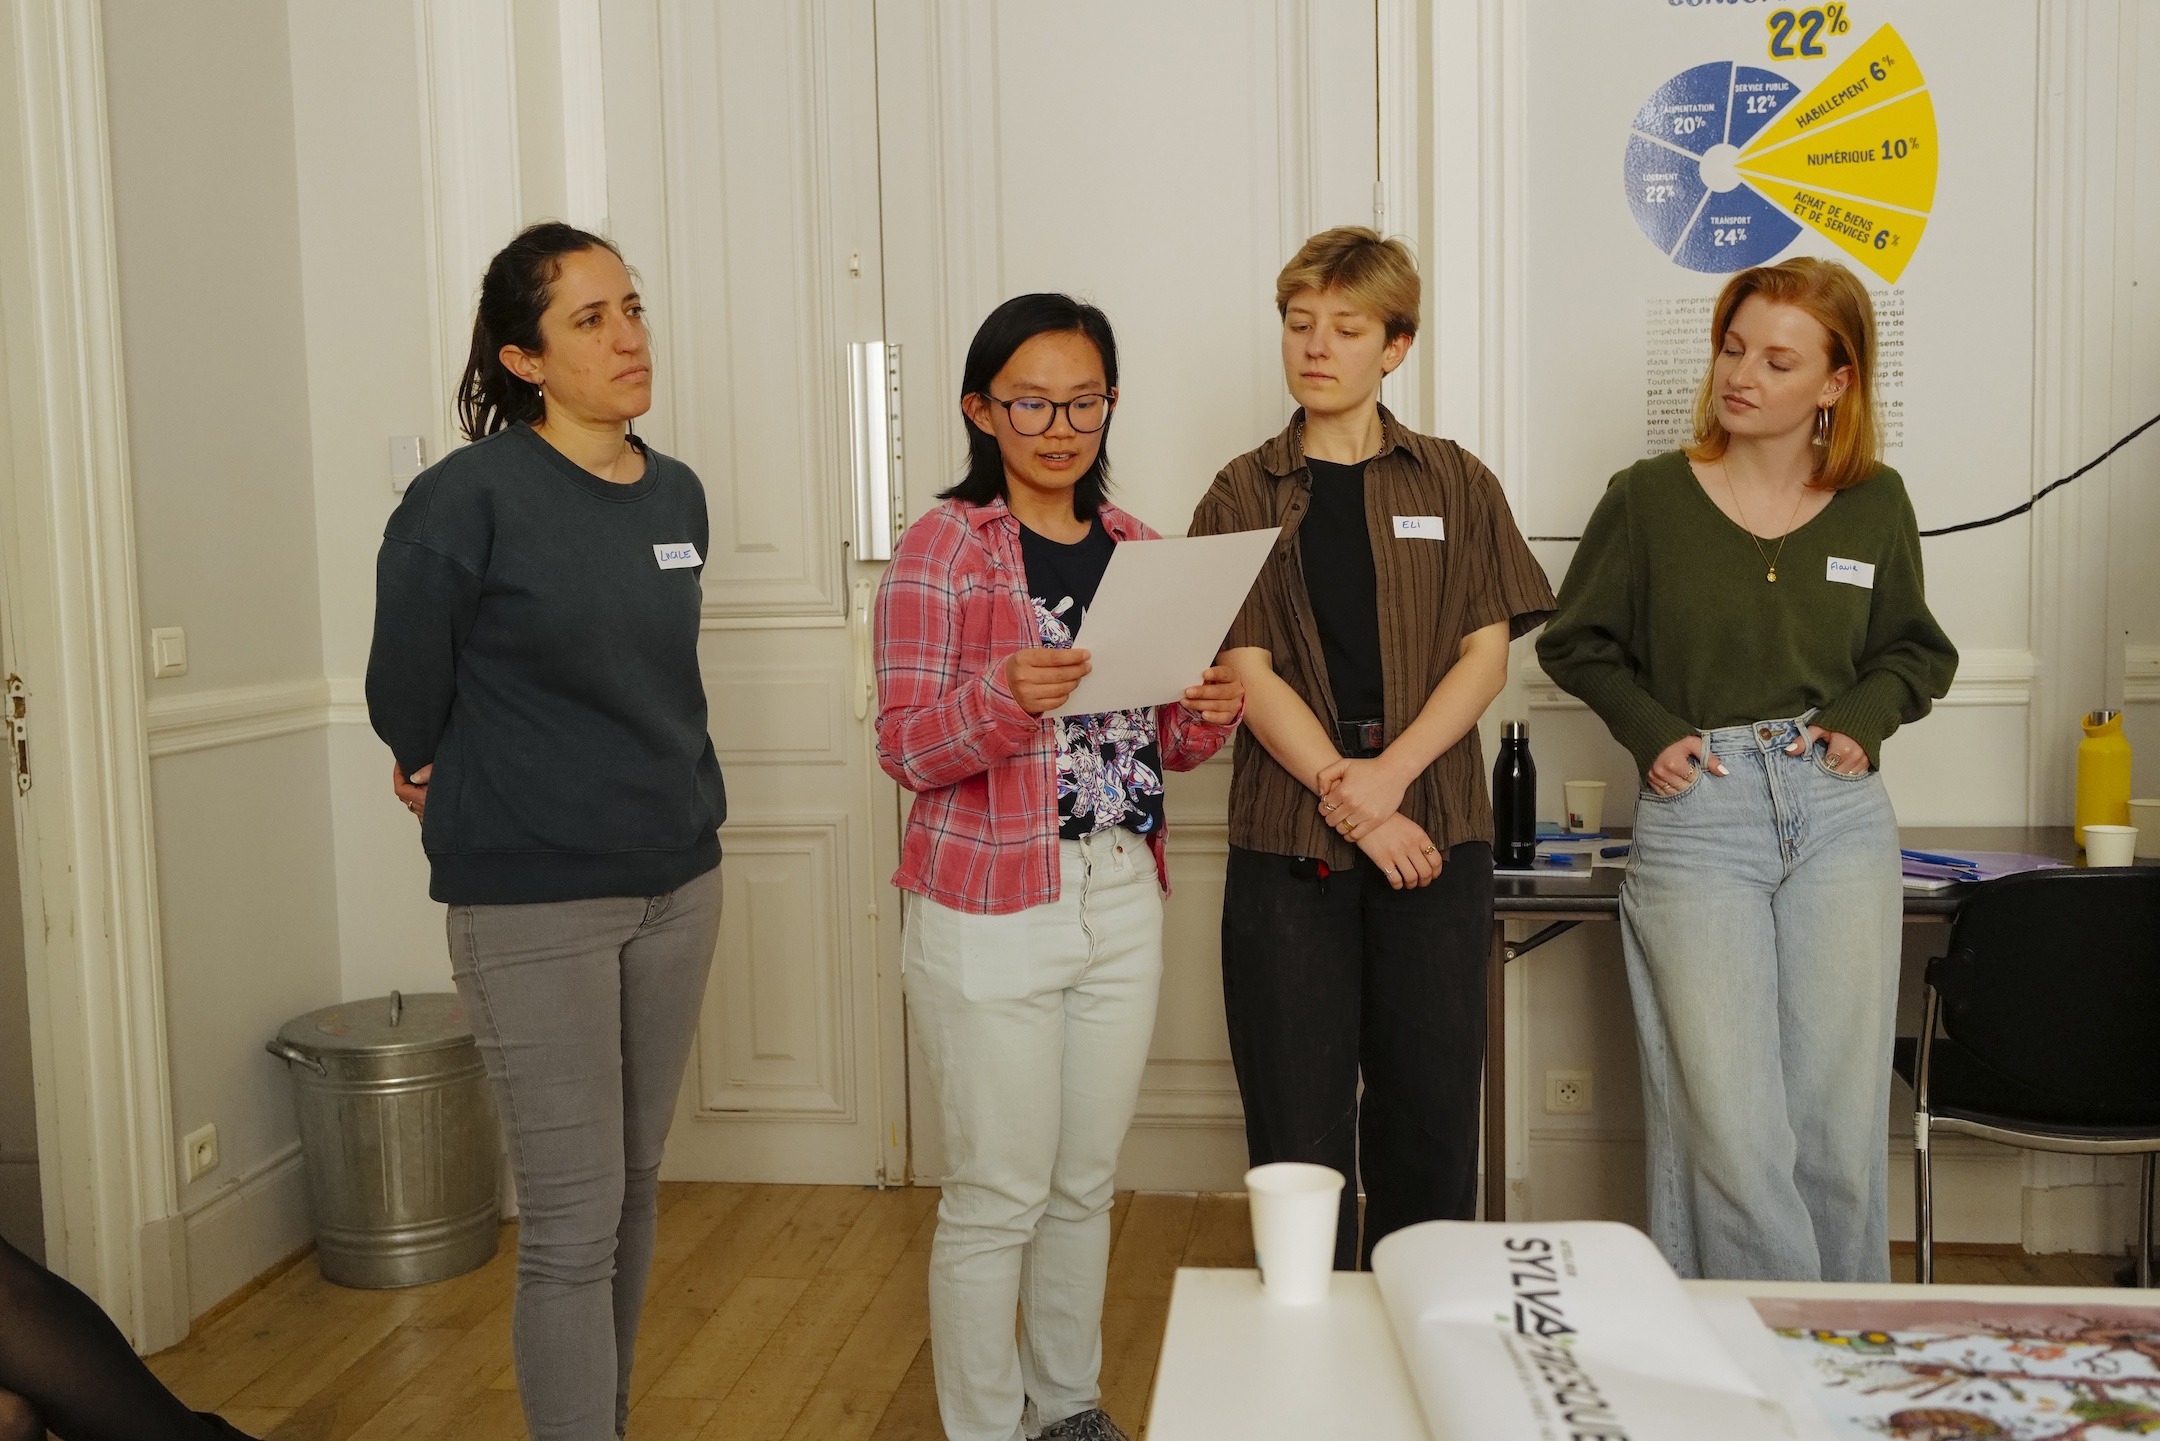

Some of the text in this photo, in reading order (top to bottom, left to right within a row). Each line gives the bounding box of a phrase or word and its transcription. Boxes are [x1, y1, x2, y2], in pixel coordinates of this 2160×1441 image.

[1768, 3, 1849, 59] 22%
[1734, 82, 1789, 93] SERVICE PUBLIC
[1746, 94, 1777, 114] 12%
[1795, 77, 1869, 128] HABILLEMENT
[1664, 103, 1715, 114] ALIMENTATION
[1673, 115, 1706, 135] 20%
[1807, 149, 1875, 166] NUMÉRIQUE
[1643, 173, 1678, 182] LOGEMENT
[1645, 185, 1676, 203] 22%
[1793, 191, 1873, 232] ACHAT DE BIENS
[1710, 216, 1752, 225] TRANSPORT
[1793, 203, 1870, 244] ET DE SERVICES
[1713, 227, 1747, 247] 24%
[1890, 308, 1905, 317] qui
[1892, 319, 1905, 327] de
[1892, 369, 1904, 377] de
[1646, 389, 1663, 397] gaz
[1892, 400, 1904, 408] de
[1647, 407, 1691, 416] Le secteu
[1646, 417, 1670, 426] serre
